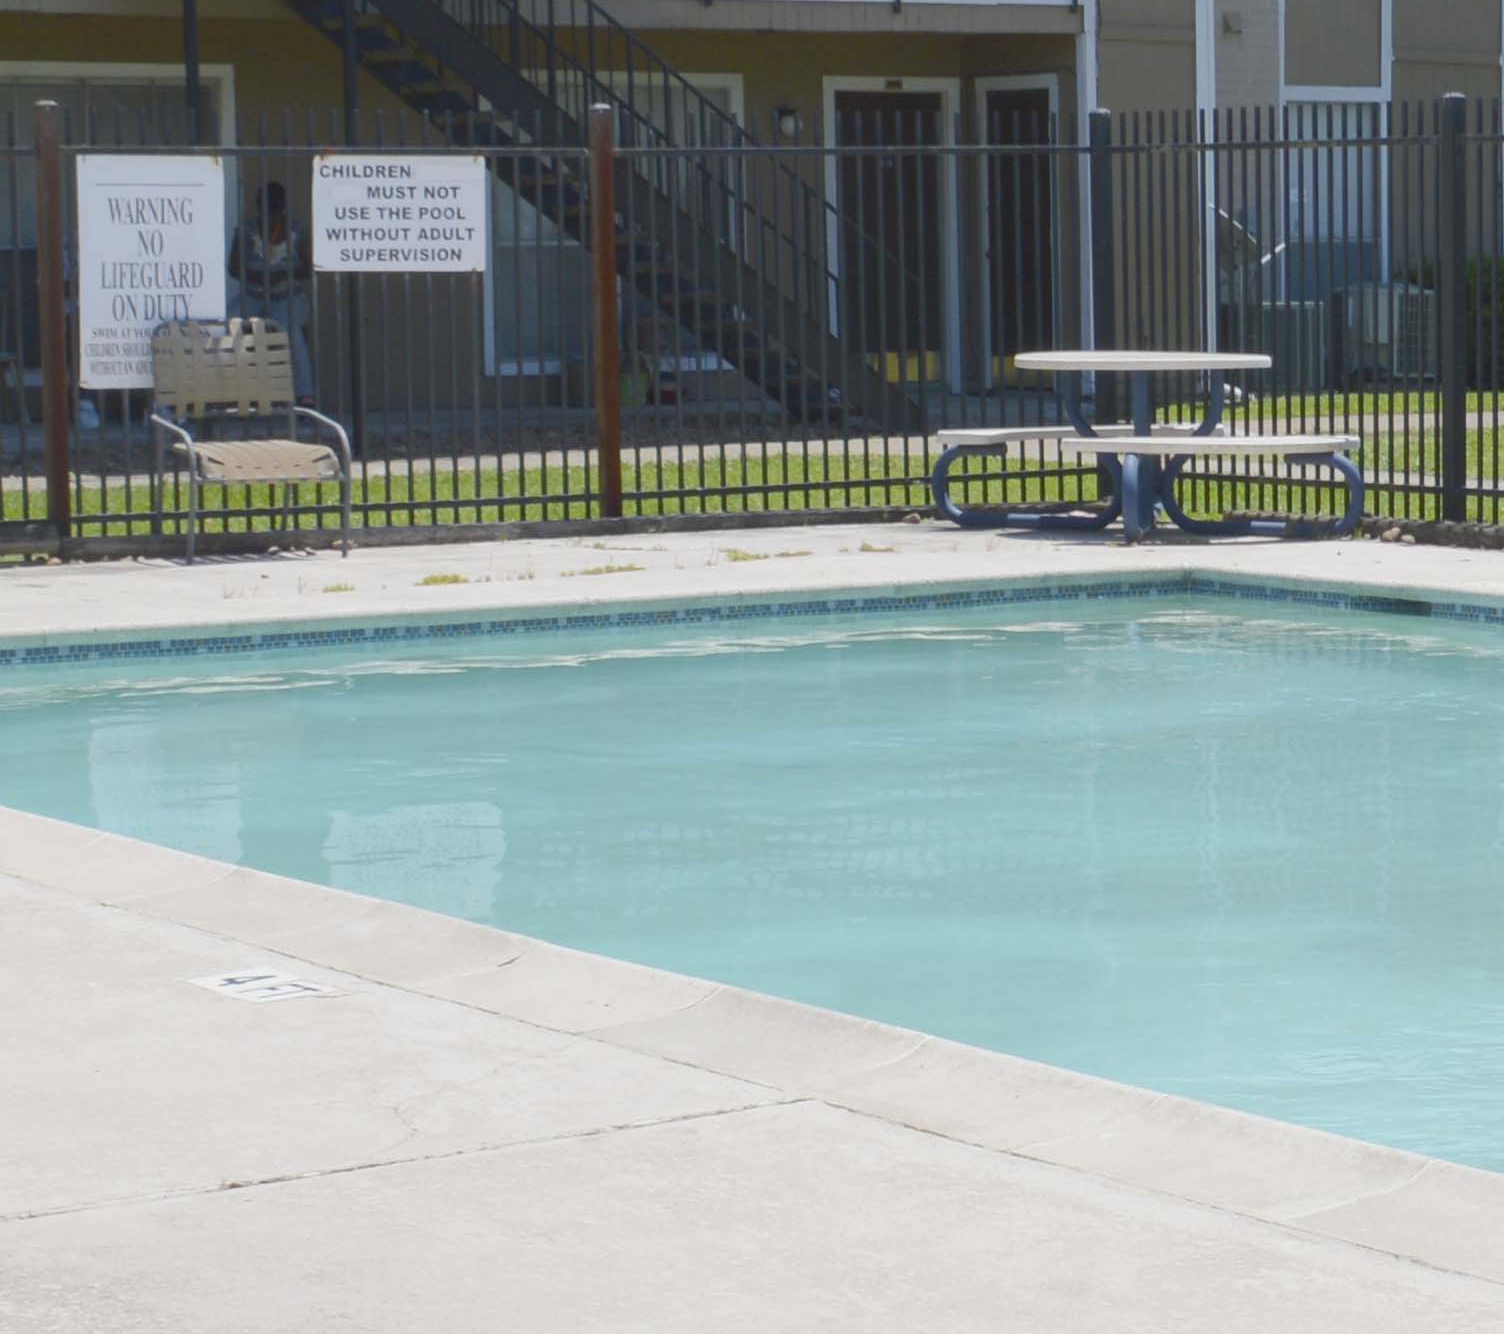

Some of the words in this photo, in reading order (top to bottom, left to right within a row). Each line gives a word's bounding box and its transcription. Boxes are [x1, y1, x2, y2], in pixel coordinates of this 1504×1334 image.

[319, 164, 412, 179] CHILDREN
[366, 185, 417, 200] MUST
[423, 185, 461, 200] NOT
[108, 197, 193, 226] WARNING
[334, 206, 371, 221] USE
[375, 206, 413, 221] THE
[418, 206, 467, 221] POOL
[326, 227, 411, 242] WITHOUT
[416, 227, 476, 242] ADULT
[137, 229, 164, 258] NO
[340, 248, 463, 263] SUPERVISION
[100, 261, 204, 290] LIFEGUARD
[112, 293, 138, 323] ON
[143, 293, 193, 322] DUTY
[92, 327, 118, 341] SWIM
[217, 974, 277, 987] 4
[237, 983, 319, 998] FT
